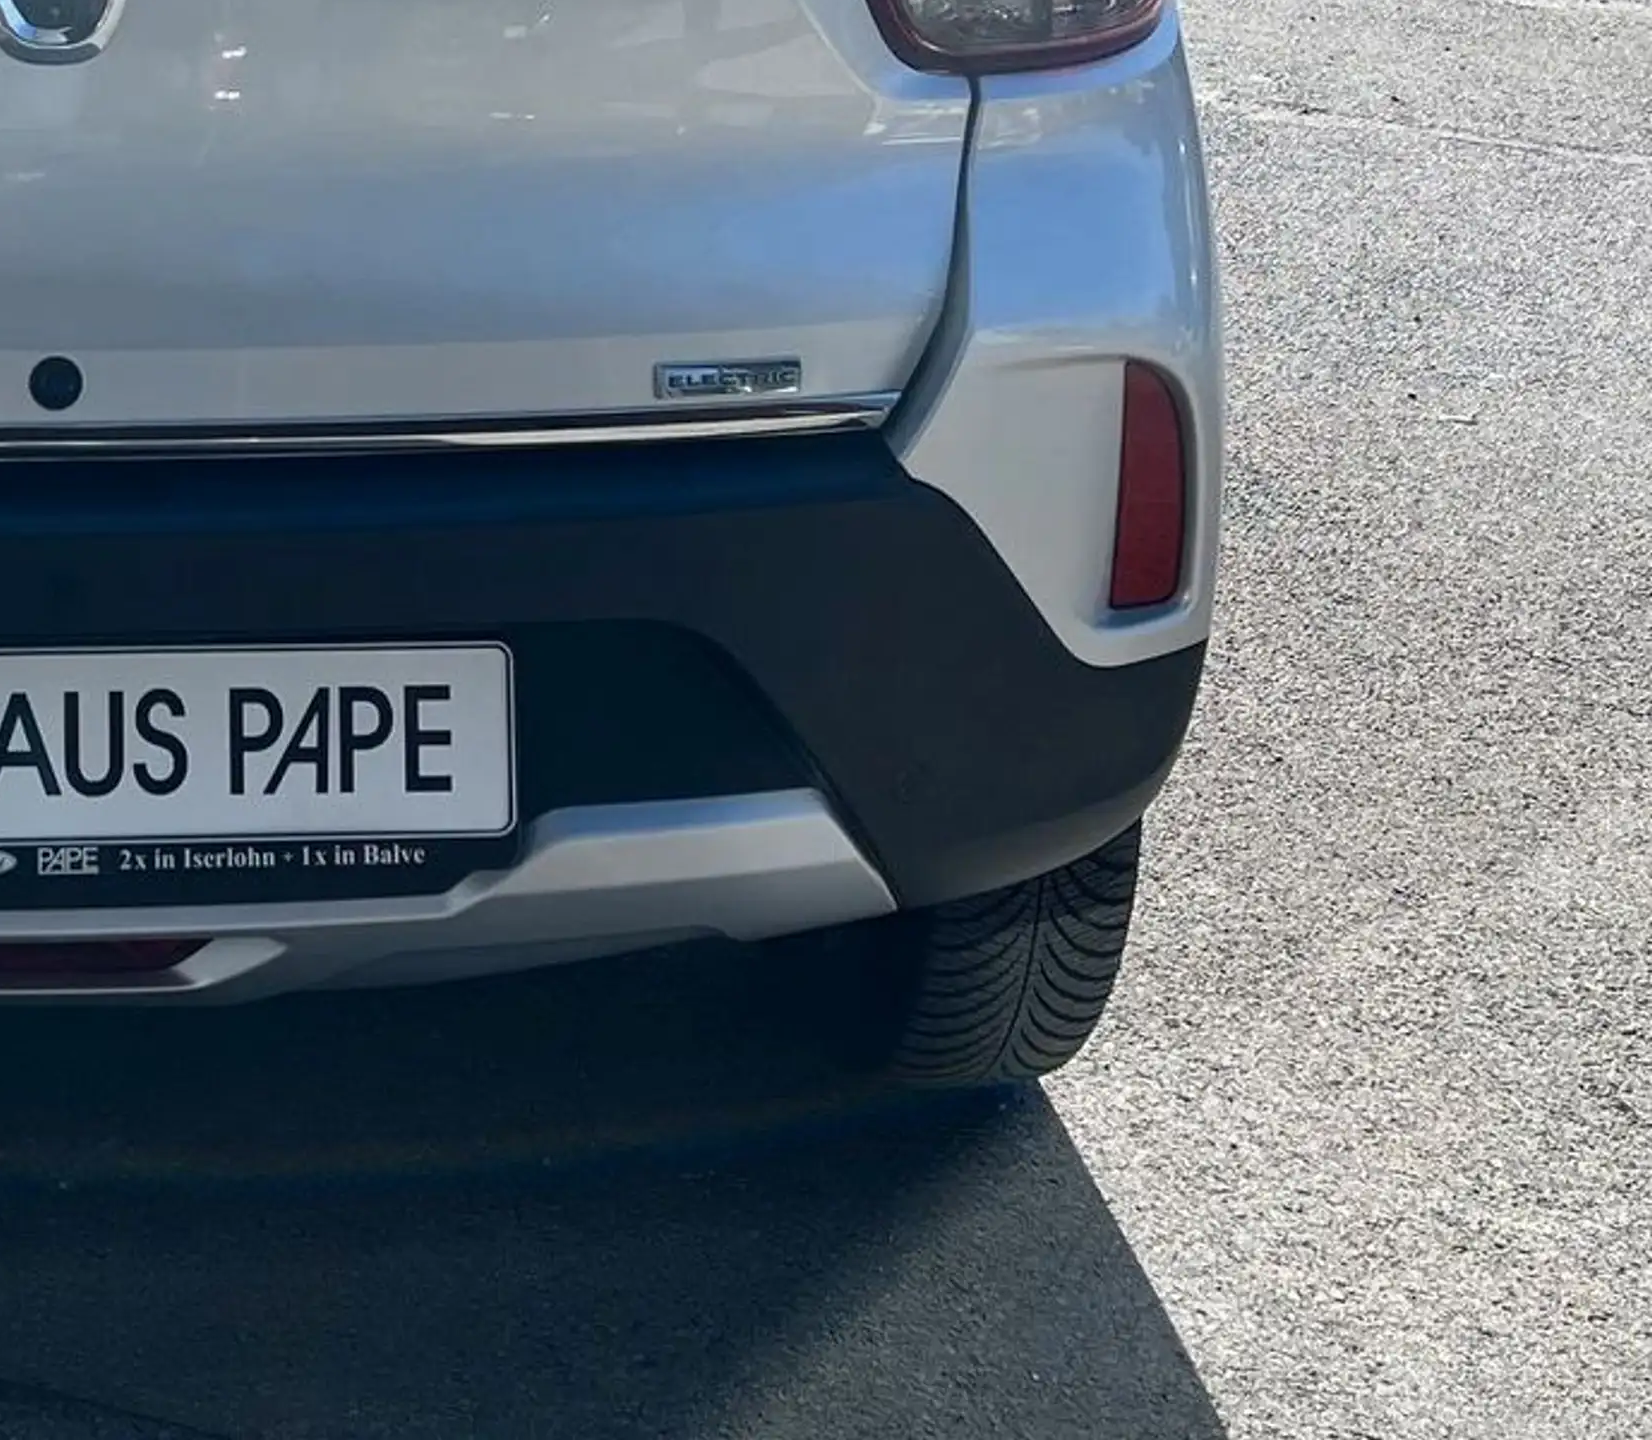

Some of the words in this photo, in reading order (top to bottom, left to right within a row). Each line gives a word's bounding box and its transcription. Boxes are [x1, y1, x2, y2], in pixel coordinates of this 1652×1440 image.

[667, 369, 796, 388] ELECTRIC
[229, 684, 453, 796] PAPE
[37, 847, 99, 875] PAPE
[119, 849, 147, 871] 2x
[154, 847, 175, 869] in
[184, 846, 276, 869] Iserlohn
[302, 845, 326, 866] 1x
[334, 844, 355, 865] in
[363, 843, 425, 865] Balve
